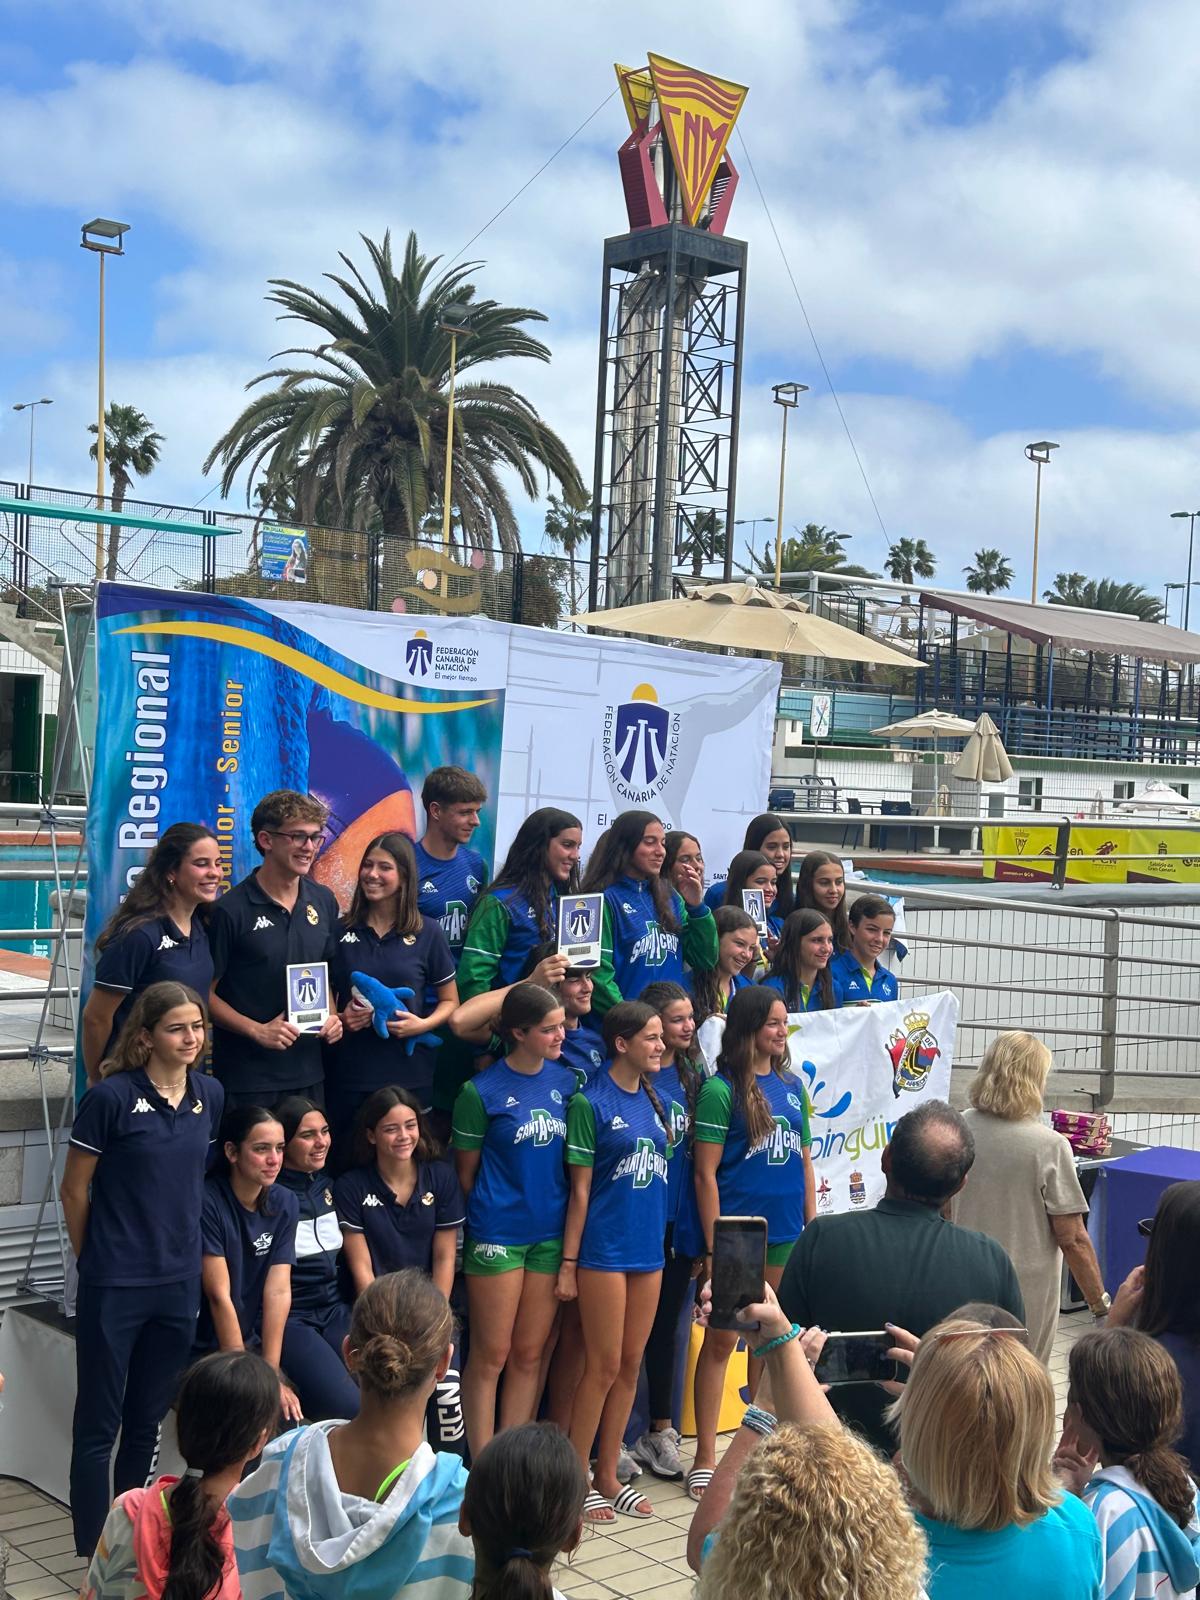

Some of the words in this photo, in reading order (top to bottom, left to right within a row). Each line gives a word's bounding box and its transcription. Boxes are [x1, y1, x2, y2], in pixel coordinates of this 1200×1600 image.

[436, 646, 479, 656] FEDERACIÓN
[435, 655, 466, 664] CANARIA
[467, 657, 477, 665] DE
[435, 664, 470, 672] NATACIÓN
[216, 679, 244, 773] Senior
[119, 651, 170, 848] Regional
[602, 705, 618, 784] FEDERACIÓN
[616, 783, 657, 803] CANARIA
[656, 775, 669, 792] DE
[665, 712, 681, 775] NATACIÓN
[597, 813, 608, 826] El
[712, 872, 728, 880] SANT
